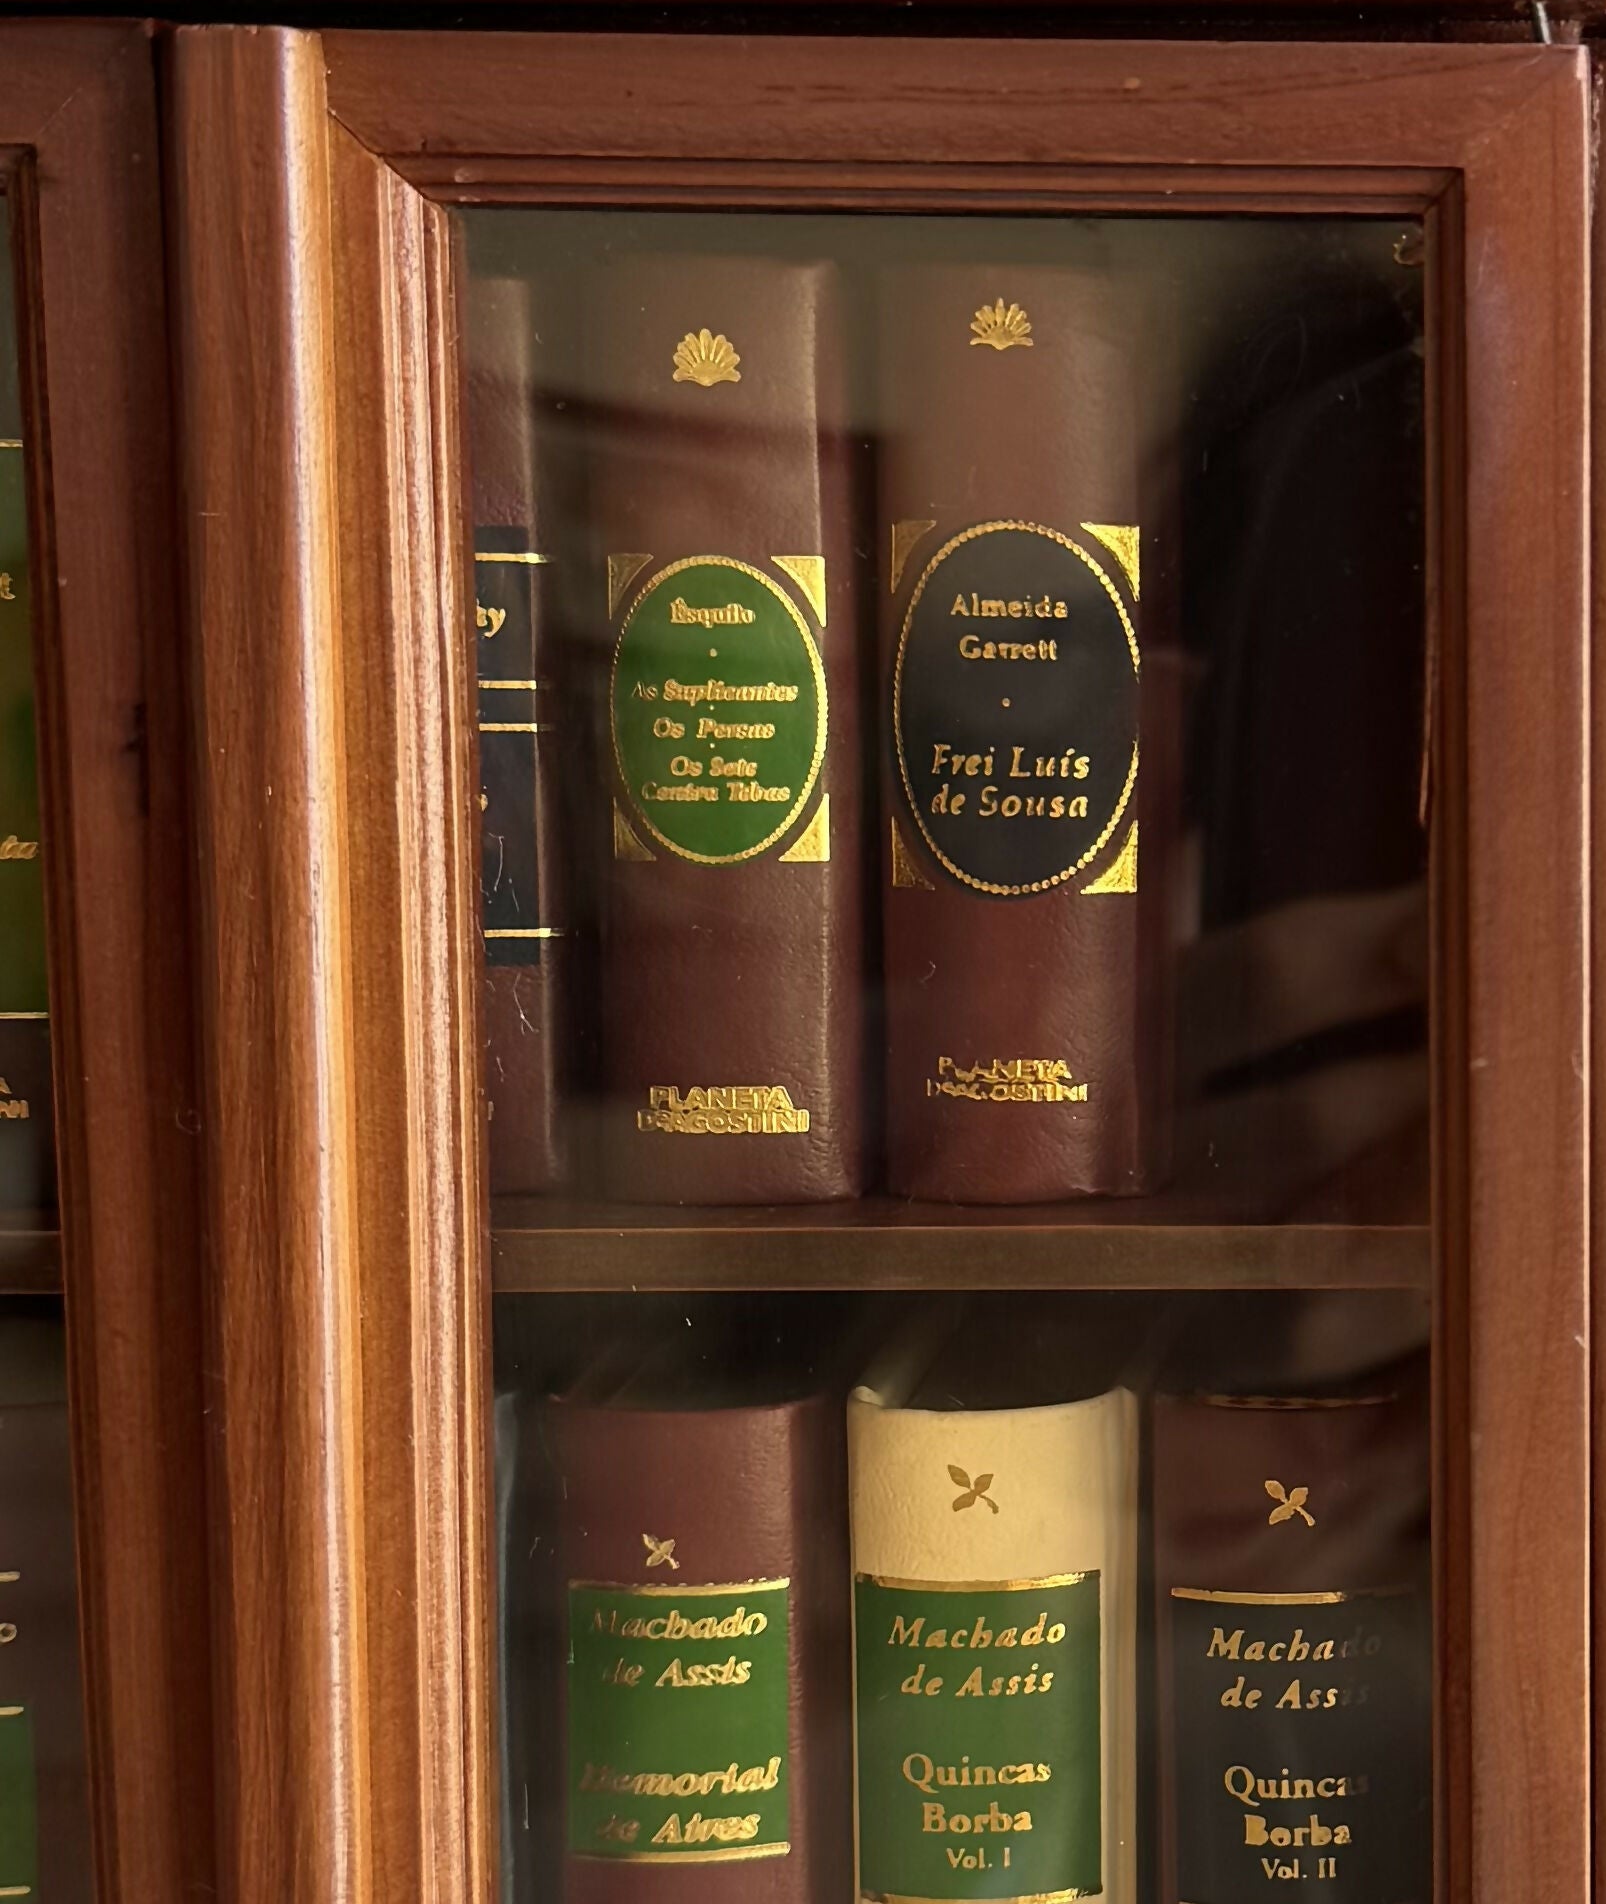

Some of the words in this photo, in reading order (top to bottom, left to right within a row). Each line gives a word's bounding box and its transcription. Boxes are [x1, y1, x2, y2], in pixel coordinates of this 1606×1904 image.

[950, 591, 1070, 620] Almeida
[959, 634, 1059, 662] Garrett
[652, 717, 686, 739] Os
[695, 716, 777, 739] Persas
[670, 756, 703, 777] Os
[708, 756, 758, 777] Sete
[930, 743, 996, 777] Frei
[641, 781, 720, 802] Contra
[726, 780, 791, 802] Tebas
[930, 782, 967, 816] de
[978, 785, 1089, 819] Sousa
[649, 1085, 795, 1111] PLANETA
[887, 1611, 1067, 1649] Machado
[654, 1655, 753, 1688] Assis
[900, 1663, 945, 1697] de
[954, 1662, 1055, 1698] Assis
[1219, 1675, 1264, 1710] de
[901, 1752, 1053, 1795] Quincas
[650, 1812, 762, 1844] Aires
[921, 1800, 1034, 1835] Borba
[1242, 1812, 1353, 1847] Borba
[945, 1846, 993, 1870] Vol.
[1002, 1846, 1013, 1869] I
[1260, 1856, 1309, 1881] Vol.
[1317, 1856, 1337, 1880] II
